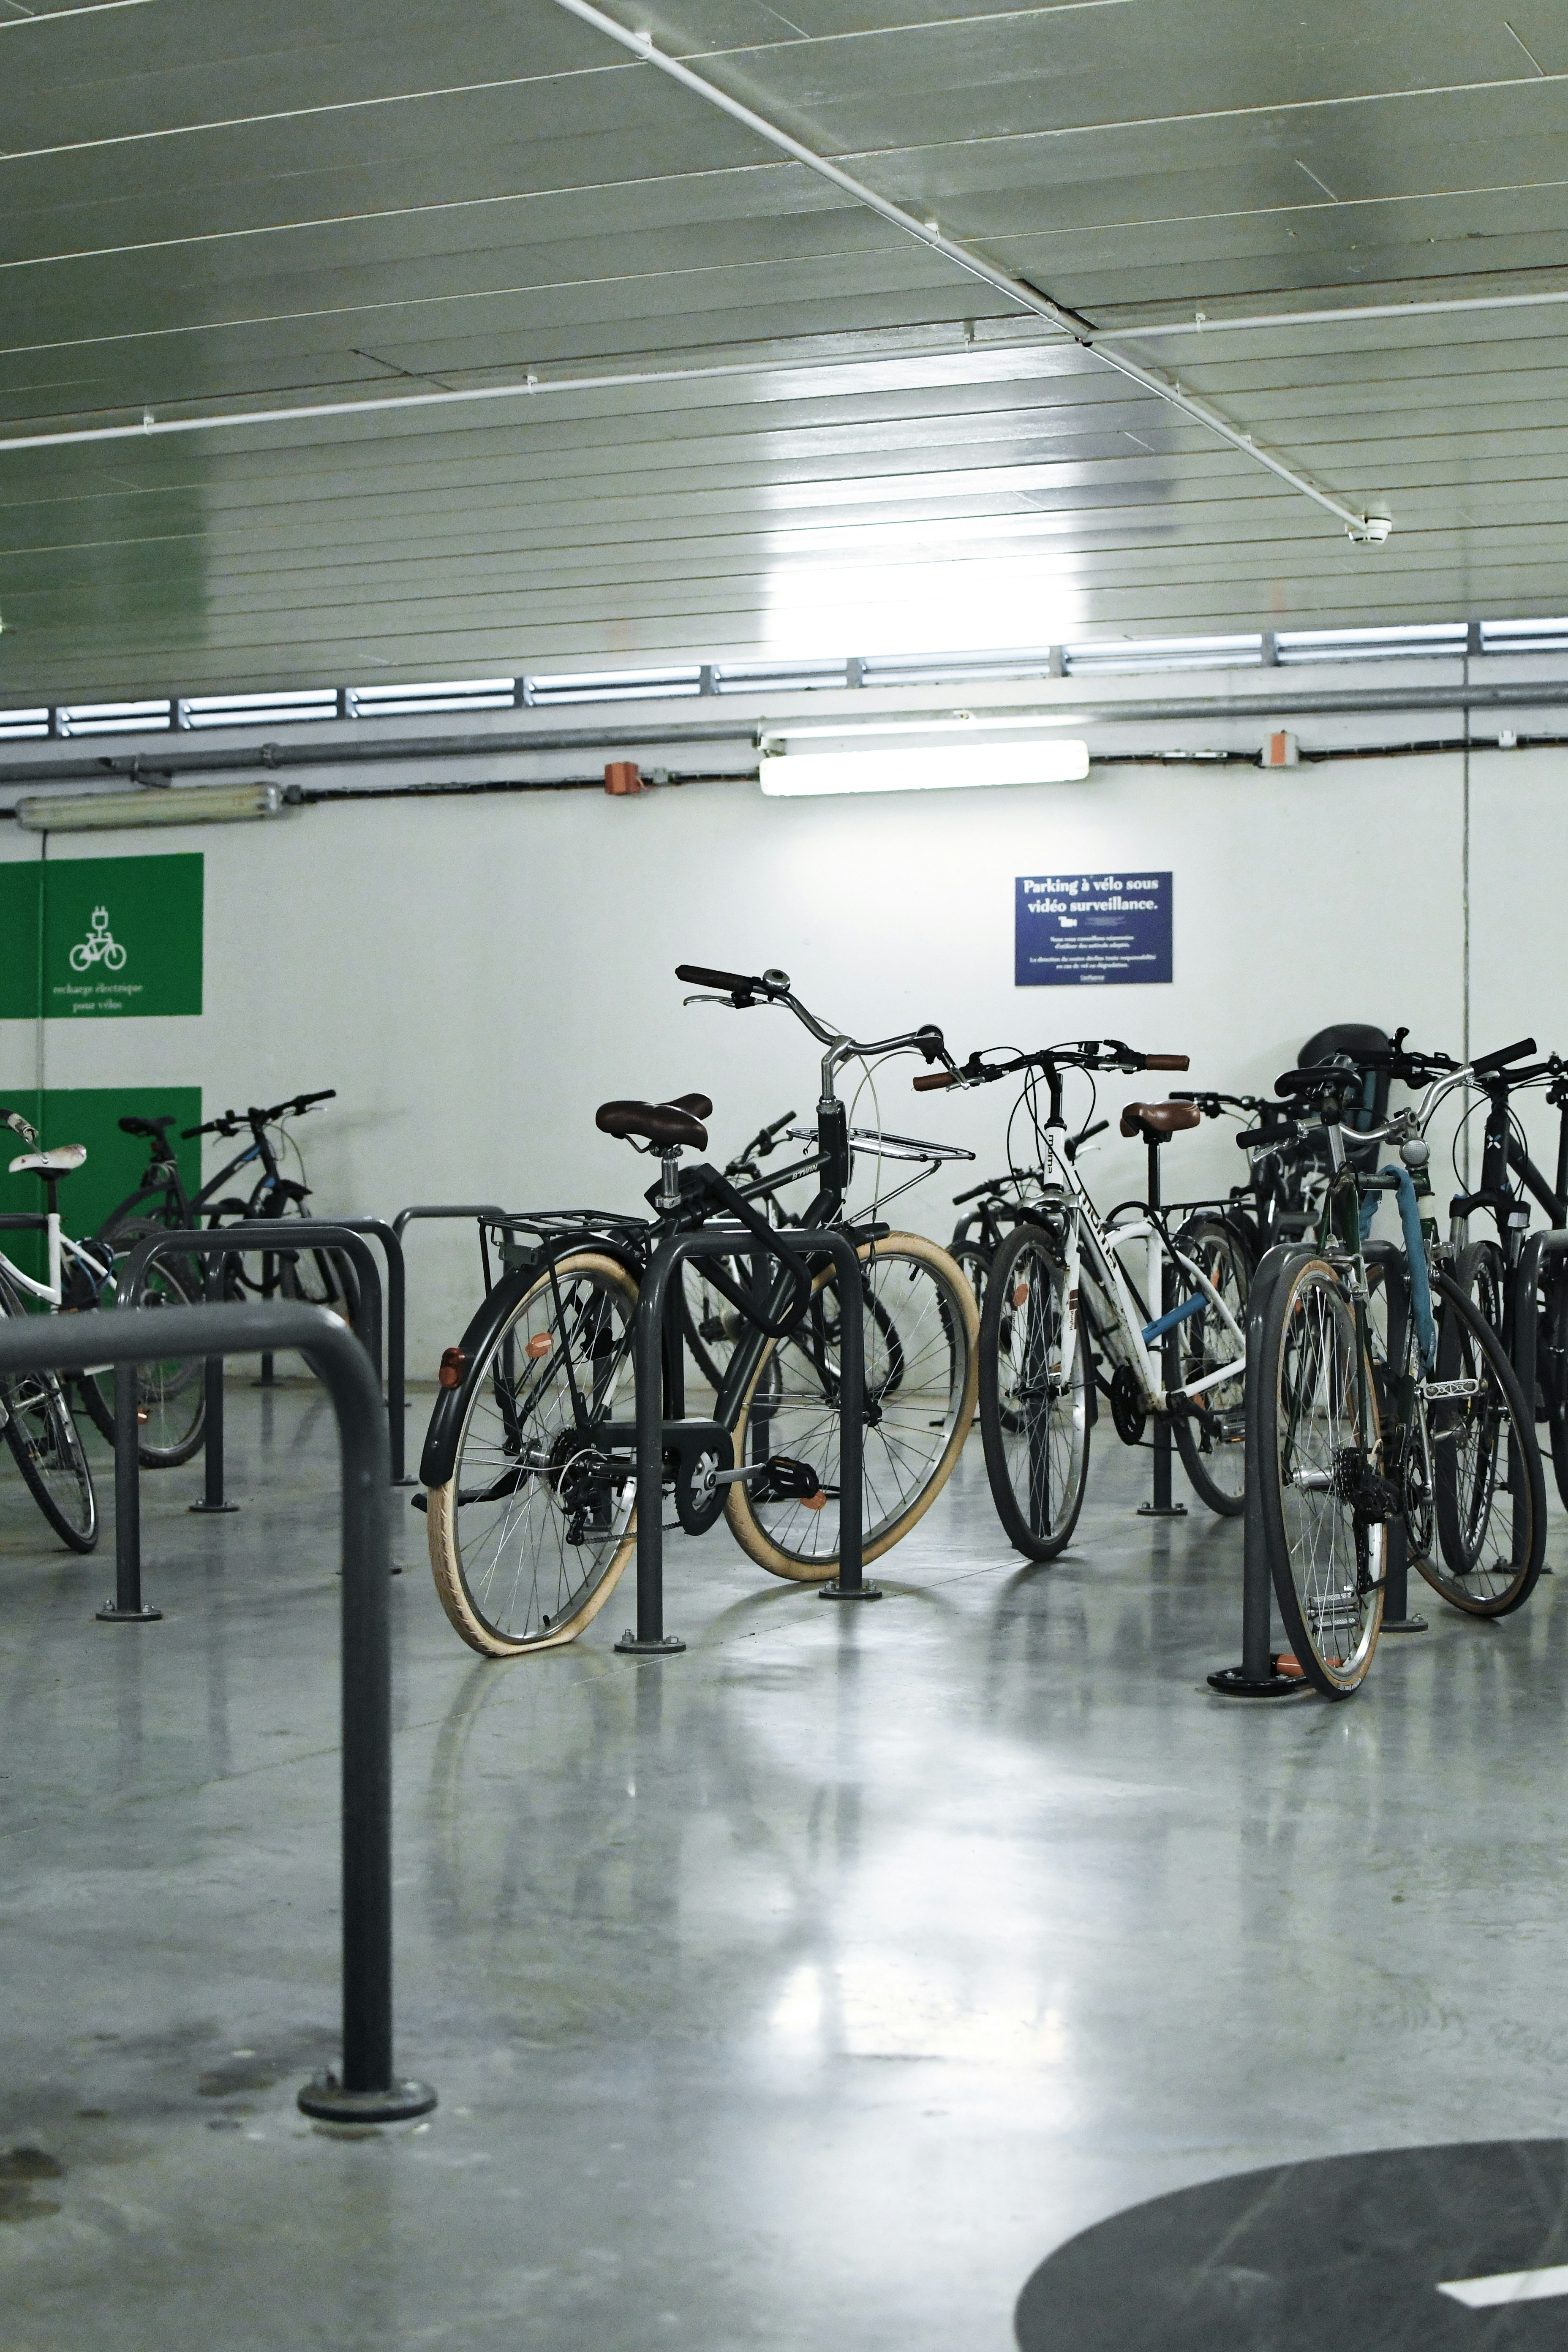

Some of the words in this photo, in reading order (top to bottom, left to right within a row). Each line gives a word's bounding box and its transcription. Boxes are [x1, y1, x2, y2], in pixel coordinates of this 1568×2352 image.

[1024, 878, 1078, 896] Parking
[1081, 879, 1089, 891] à
[1093, 876, 1123, 891] vélo
[1126, 879, 1159, 890] sous
[1028, 898, 1067, 913] vidéo
[1070, 896, 1158, 912] surveillance.
[792, 1163, 818, 1180] BTWIN
